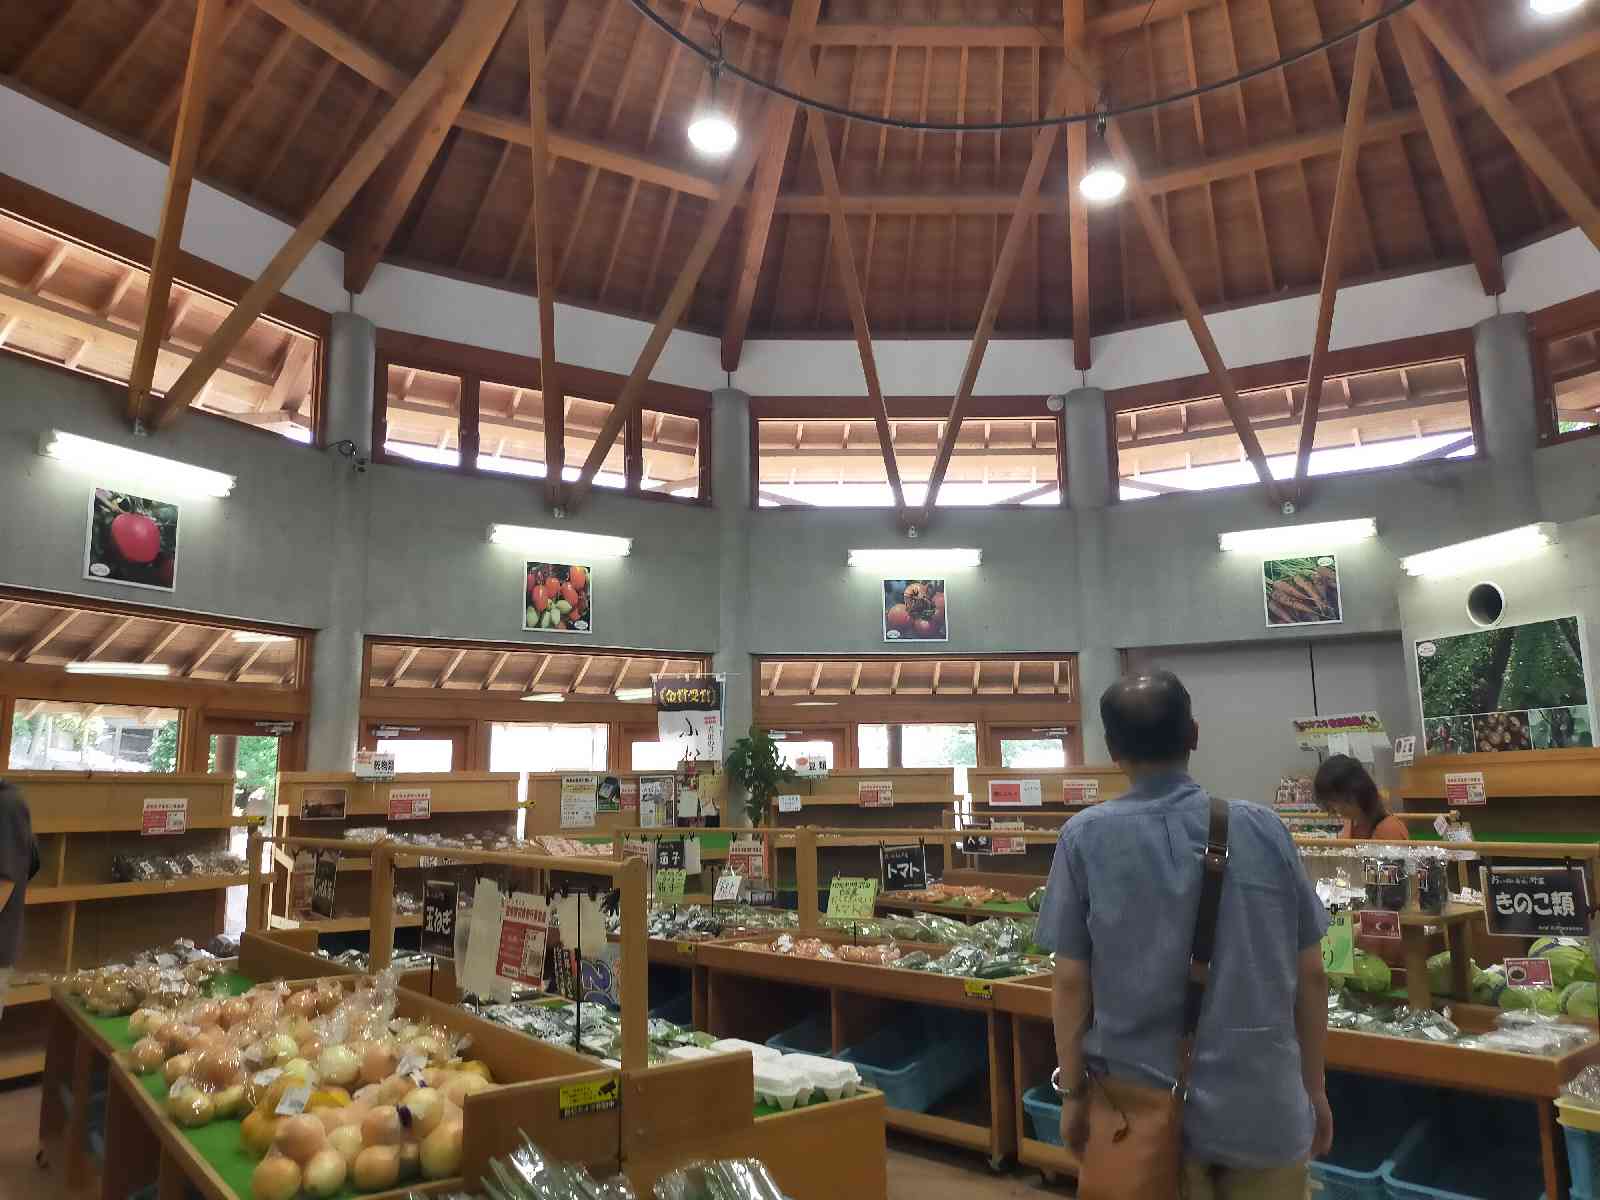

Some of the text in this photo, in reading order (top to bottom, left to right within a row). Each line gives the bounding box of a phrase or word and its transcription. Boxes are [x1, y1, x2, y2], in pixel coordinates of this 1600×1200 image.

[887, 862, 921, 879] トマト
[1495, 891, 1576, 917] きのこ類
[426, 905, 453, 935] 玉ねぎ
